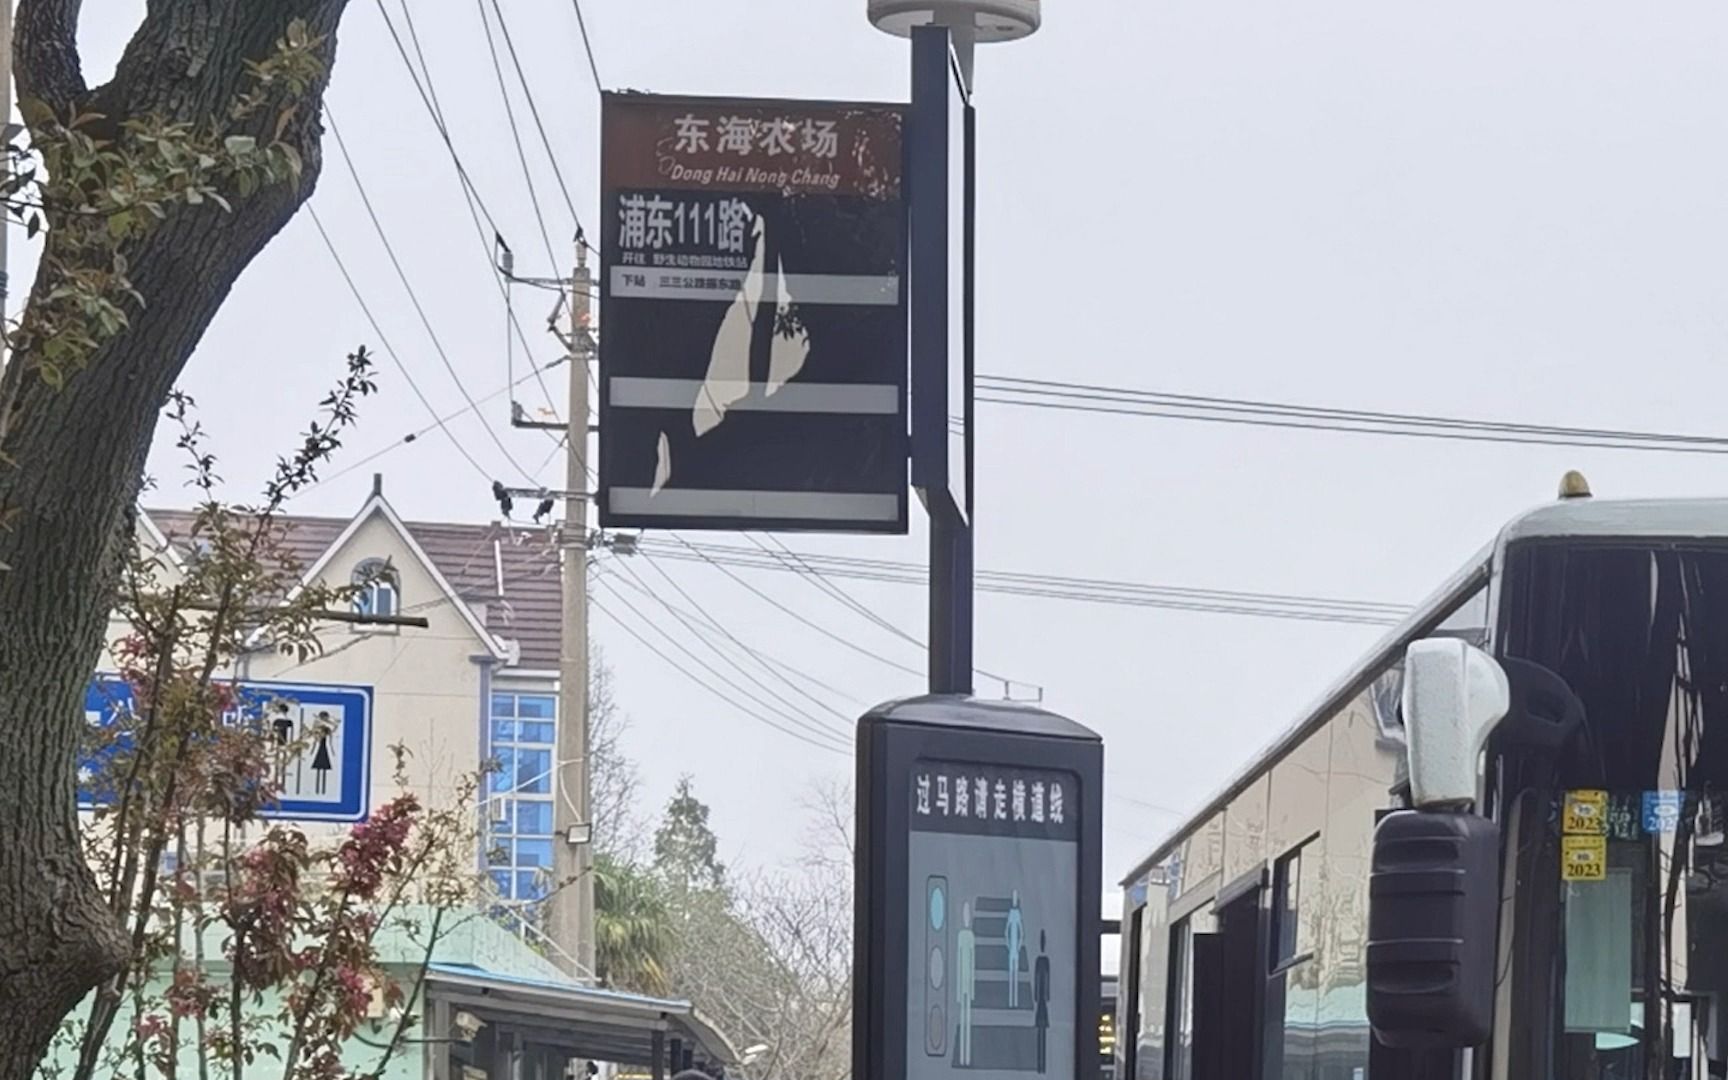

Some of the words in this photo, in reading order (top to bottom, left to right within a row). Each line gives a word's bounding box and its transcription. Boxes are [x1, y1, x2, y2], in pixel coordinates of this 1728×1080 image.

[673, 113, 838, 158] 东海农场
[671, 164, 712, 184] Dong
[716, 166, 743, 183] Hai
[745, 167, 787, 187] Nong
[791, 169, 840, 189] Chang
[618, 194, 746, 253] 浦东111路
[622, 273, 646, 288] 下站
[916, 774, 1065, 824] 过马路请走横道线
[1566, 863, 1602, 877] 2023
